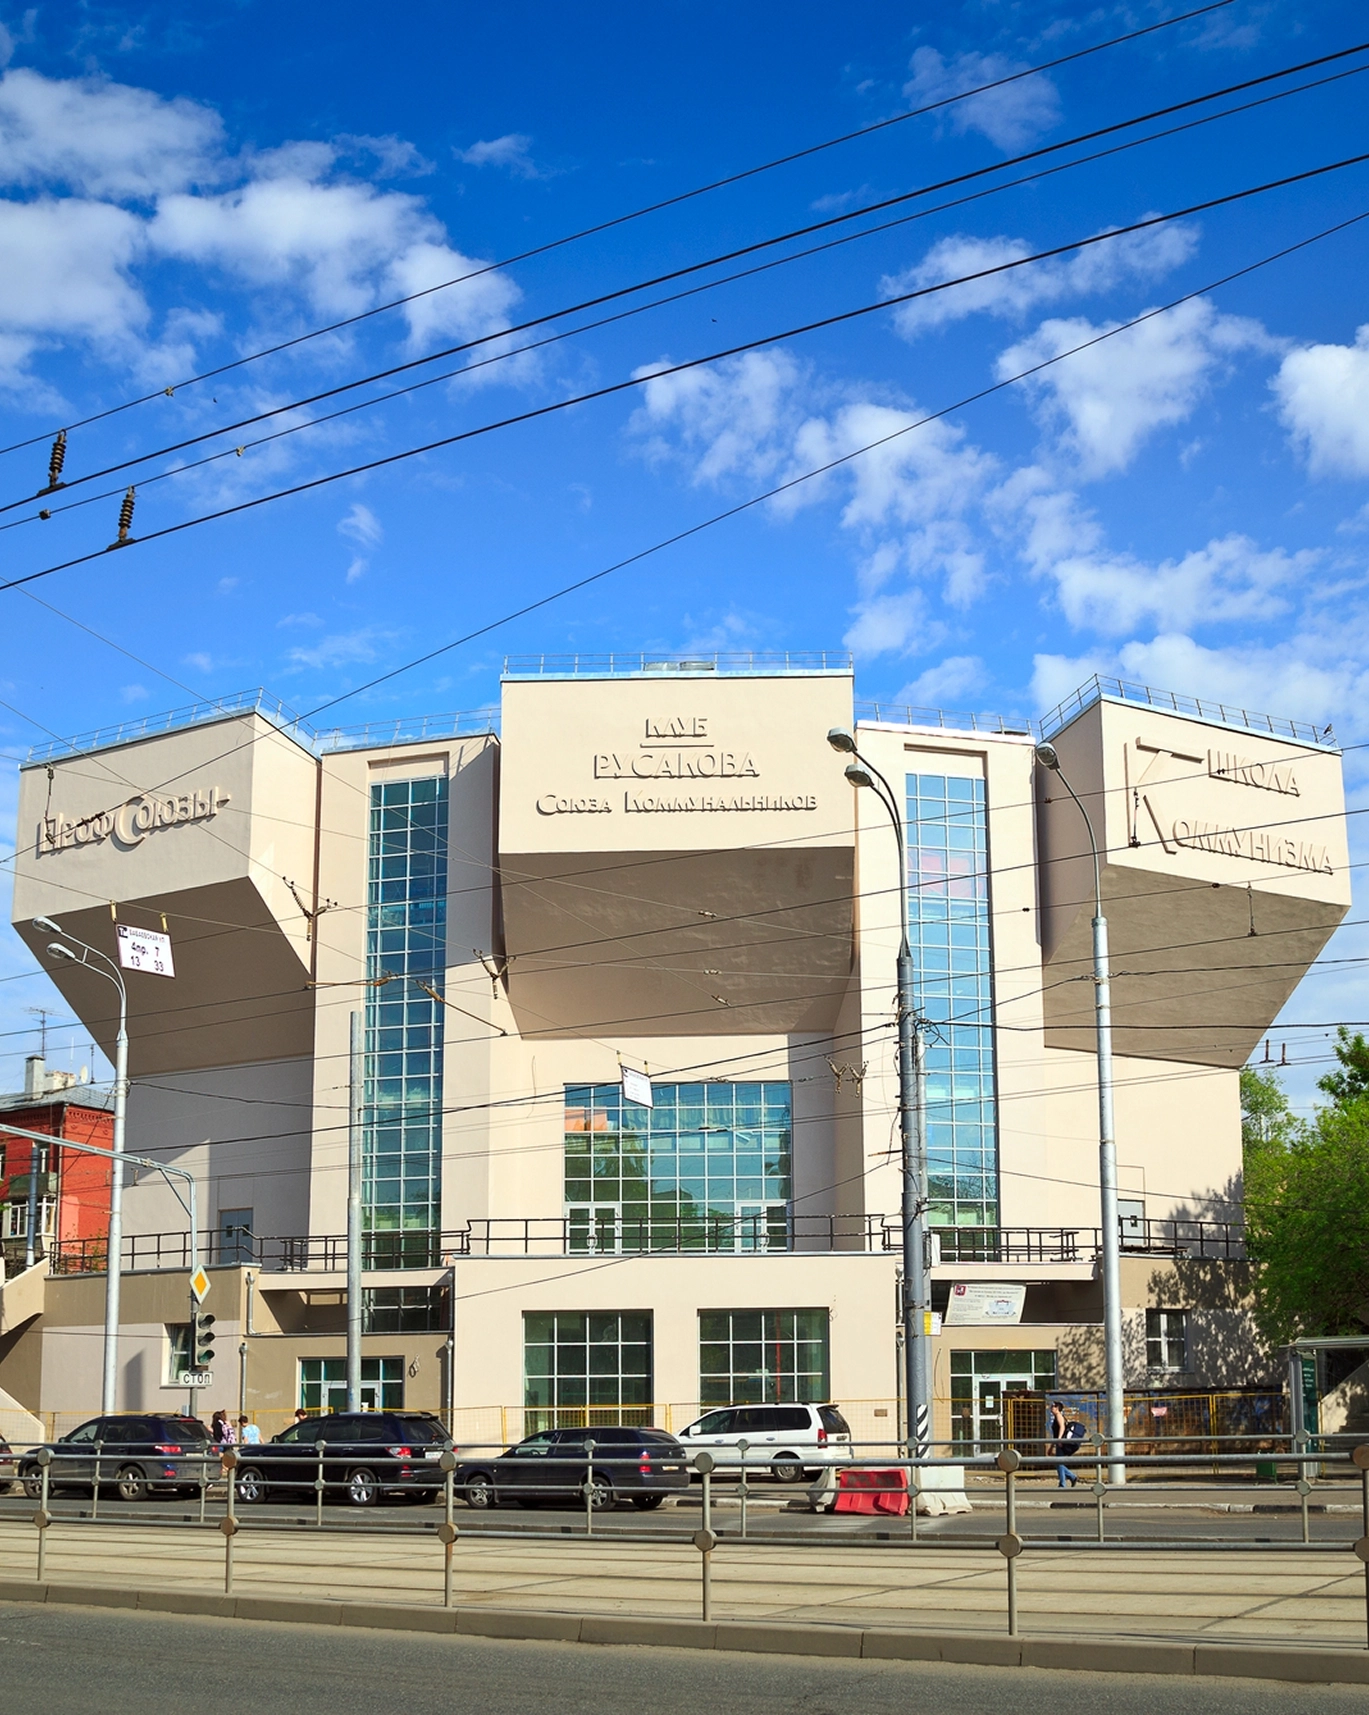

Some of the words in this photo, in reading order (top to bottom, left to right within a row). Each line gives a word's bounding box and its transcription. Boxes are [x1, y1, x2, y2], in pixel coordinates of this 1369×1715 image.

[645, 717, 708, 738] КЛУБ
[594, 752, 760, 779] РУСАКОВА
[1207, 748, 1300, 797] ШКОЛА
[154, 946, 160, 957] 7
[130, 955, 141, 967] 13
[153, 959, 165, 972] 33
[183, 1373, 211, 1384] СТОП
